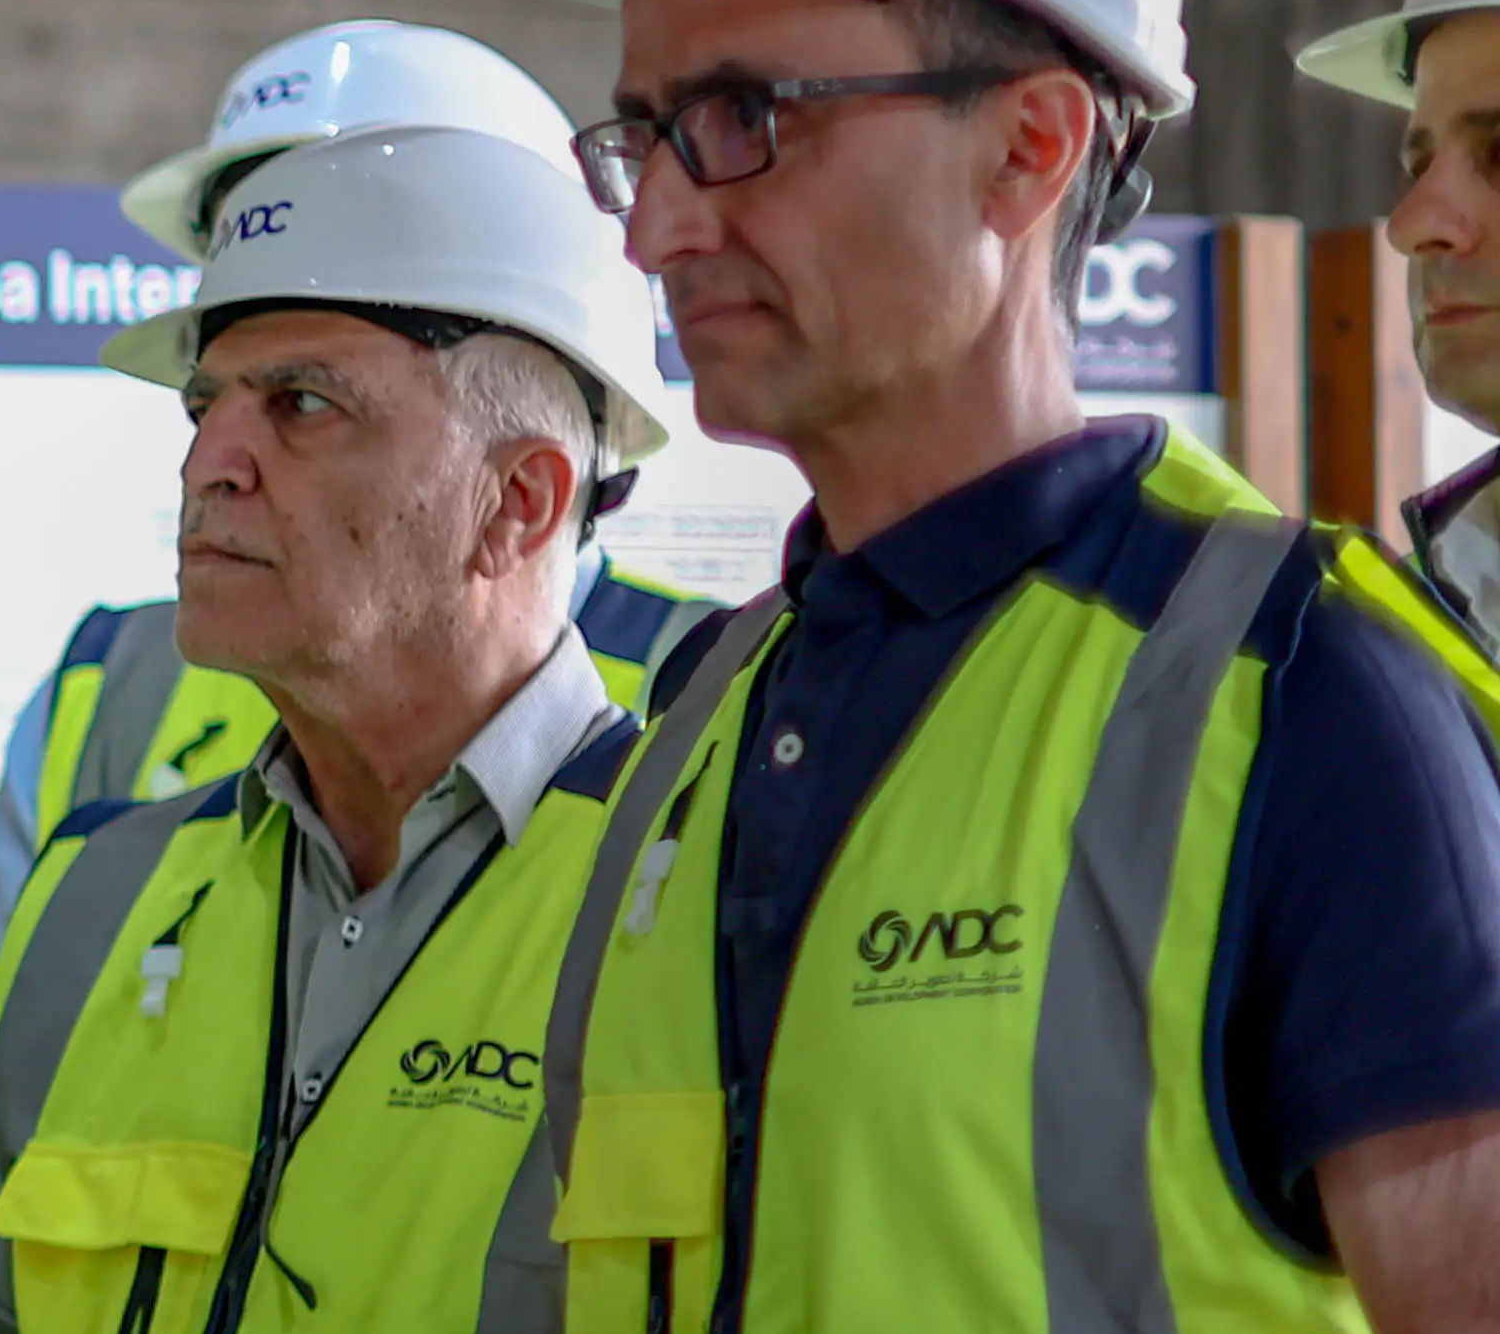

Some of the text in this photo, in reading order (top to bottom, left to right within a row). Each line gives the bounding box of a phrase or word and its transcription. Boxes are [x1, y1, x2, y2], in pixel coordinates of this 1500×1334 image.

[1077, 238, 1177, 328] DC
[908, 904, 1024, 963] ADC
[442, 1041, 541, 1089] ADC
